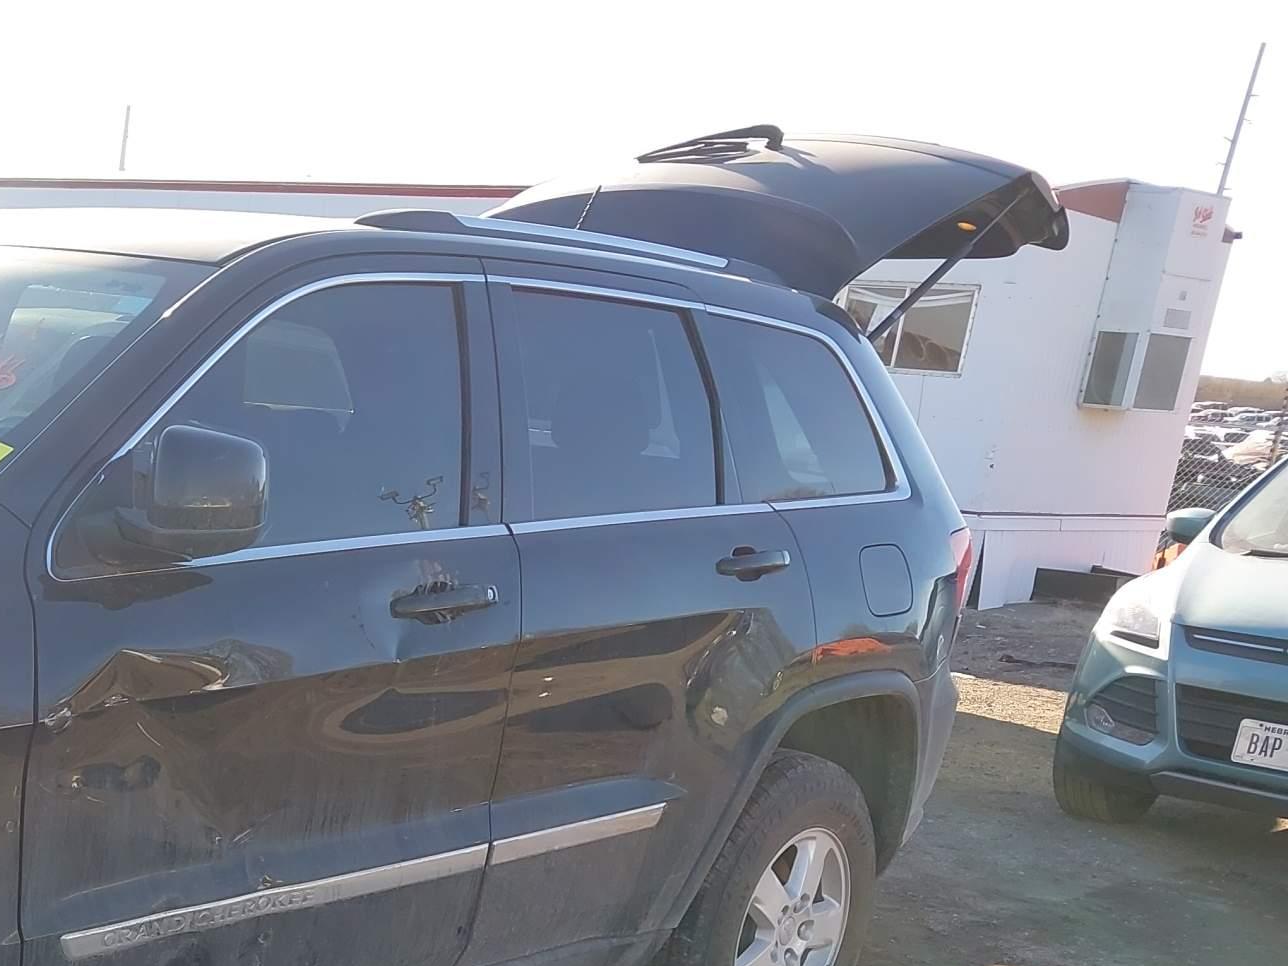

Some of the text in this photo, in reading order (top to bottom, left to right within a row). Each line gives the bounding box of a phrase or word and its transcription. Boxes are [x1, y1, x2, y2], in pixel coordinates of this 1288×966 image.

[1248, 733, 1282, 757] BAP
[102, 890, 315, 948] GRAND CHEROKEE
